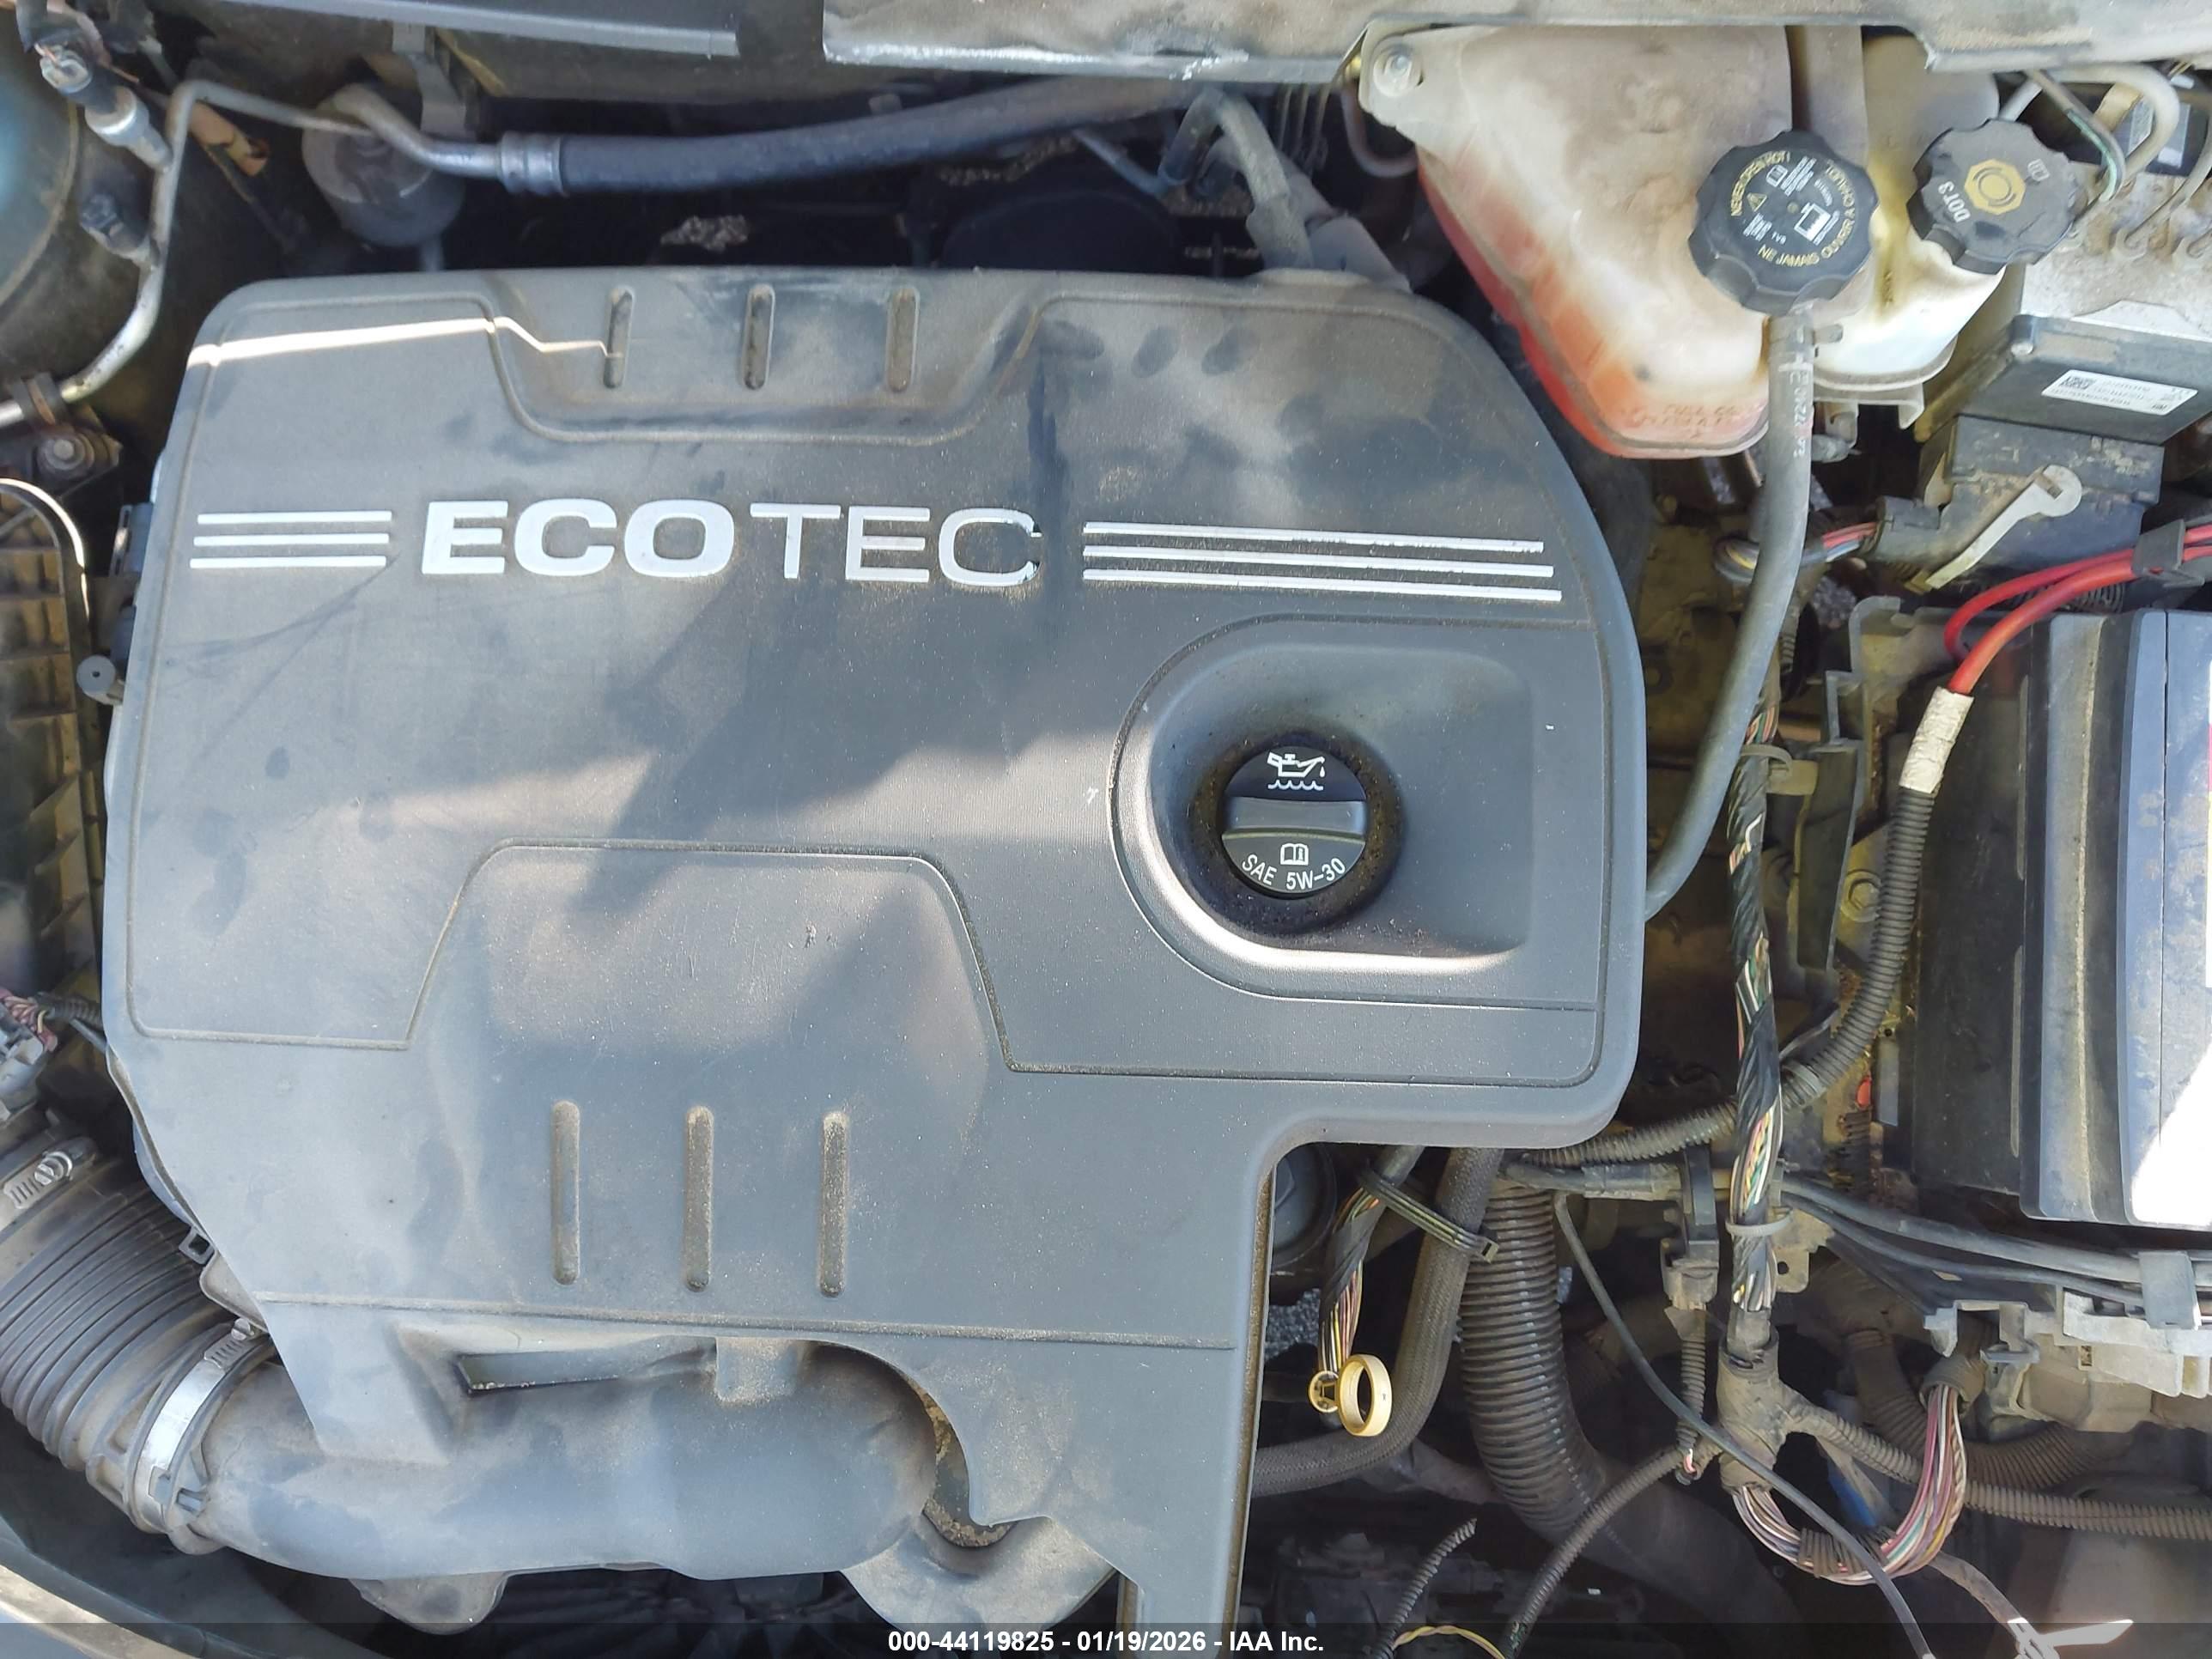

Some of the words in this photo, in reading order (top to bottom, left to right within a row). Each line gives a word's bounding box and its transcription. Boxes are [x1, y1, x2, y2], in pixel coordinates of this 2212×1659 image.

[1758, 244, 1778, 262] NE
[1775, 252, 1820, 267] JAMAIS
[422, 498, 1042, 586] ECOTEC
[1242, 854, 1277, 886] SAE
[1285, 858, 1346, 890] 5W-30
